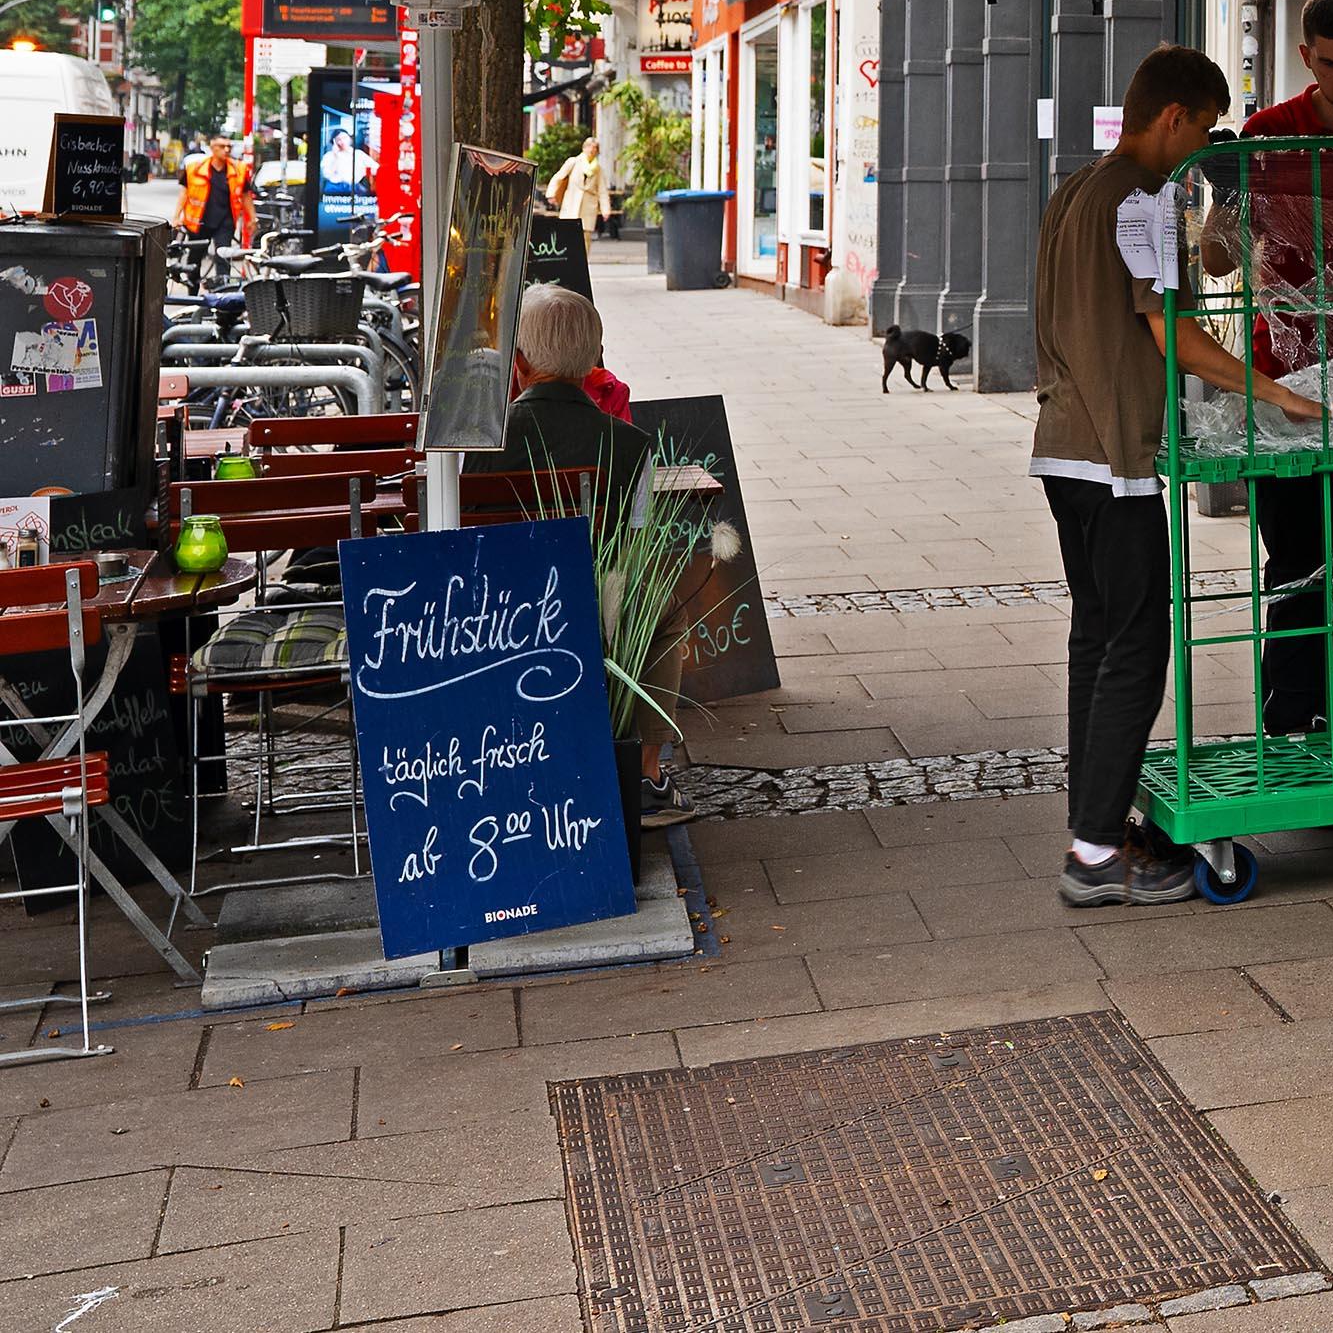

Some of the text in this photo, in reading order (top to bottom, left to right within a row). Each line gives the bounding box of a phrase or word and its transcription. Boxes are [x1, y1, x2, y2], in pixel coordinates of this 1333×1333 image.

[364, 565, 569, 669] Frühstück
[378, 722, 550, 813] täglich frisch
[398, 825, 443, 883] ab
[543, 797, 602, 852] Uhr
[485, 903, 538, 924] BIONADE
